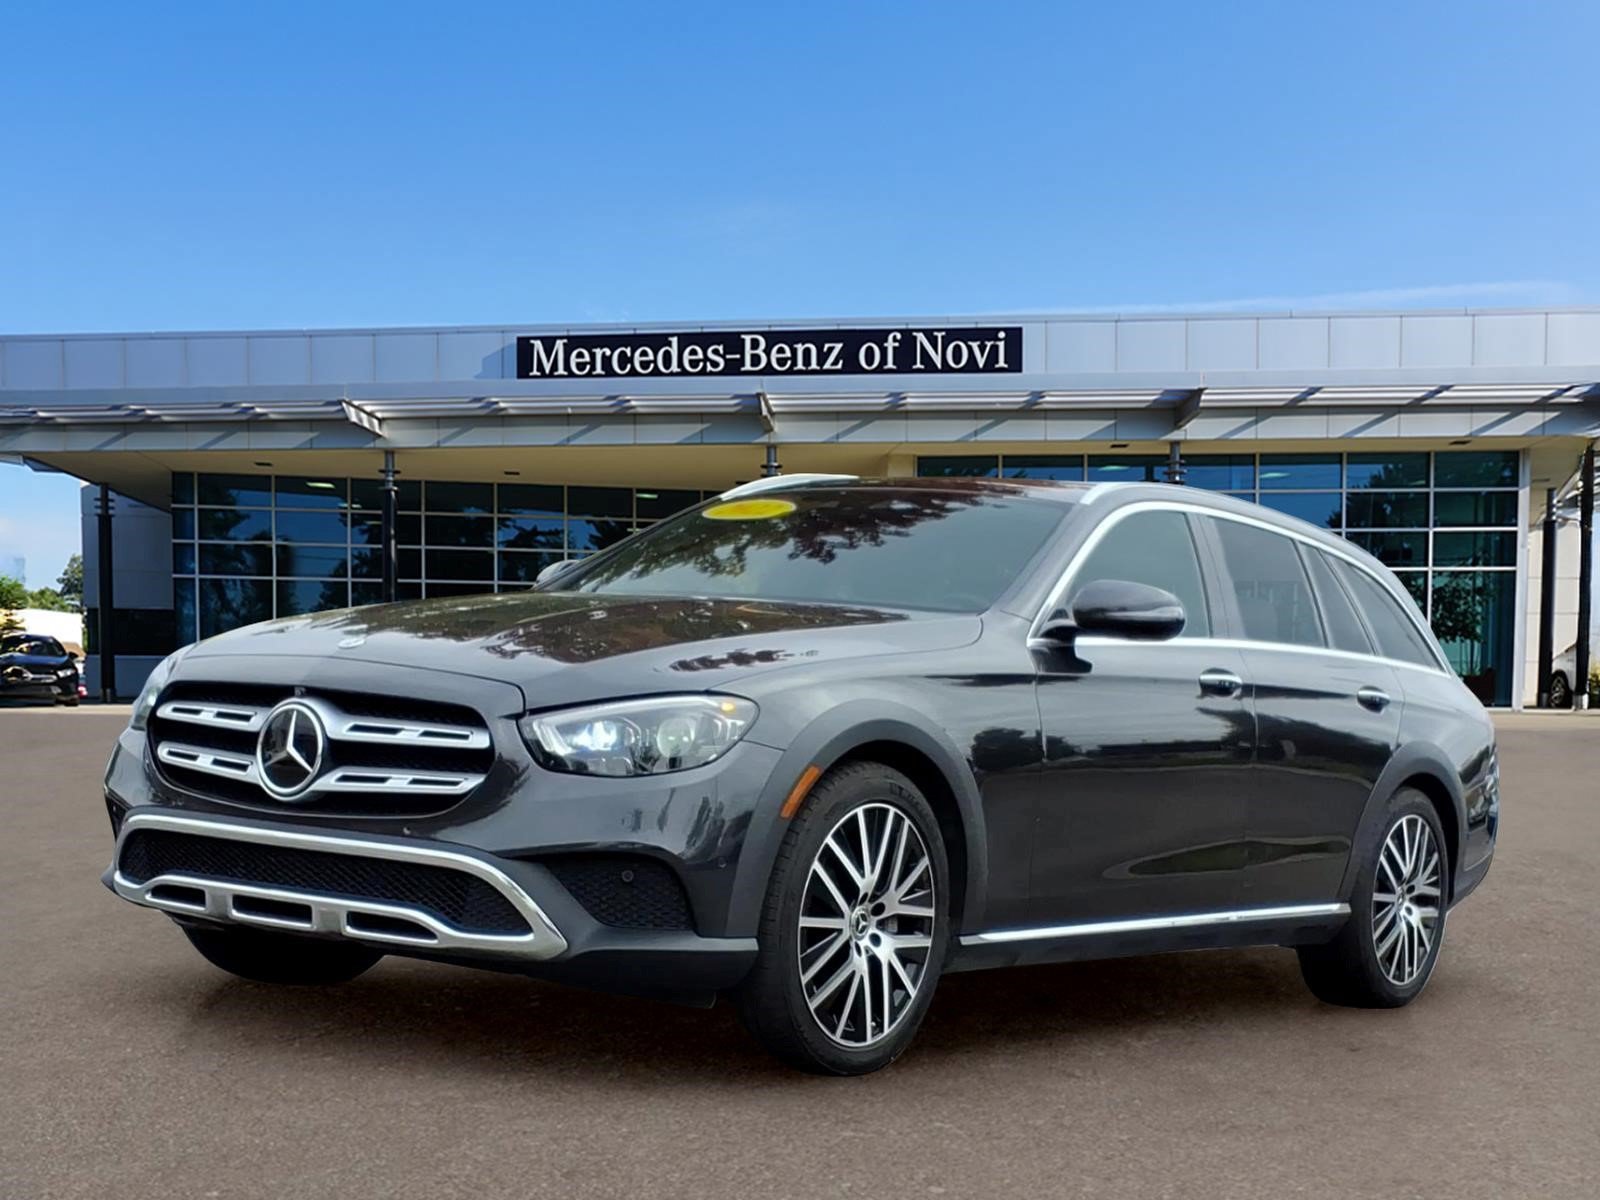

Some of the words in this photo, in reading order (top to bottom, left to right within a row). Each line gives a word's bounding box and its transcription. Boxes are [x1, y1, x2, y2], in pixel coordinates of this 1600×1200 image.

[529, 334, 844, 376] Mercedes-Benz
[858, 331, 902, 370] of
[912, 330, 1009, 369] Novi
